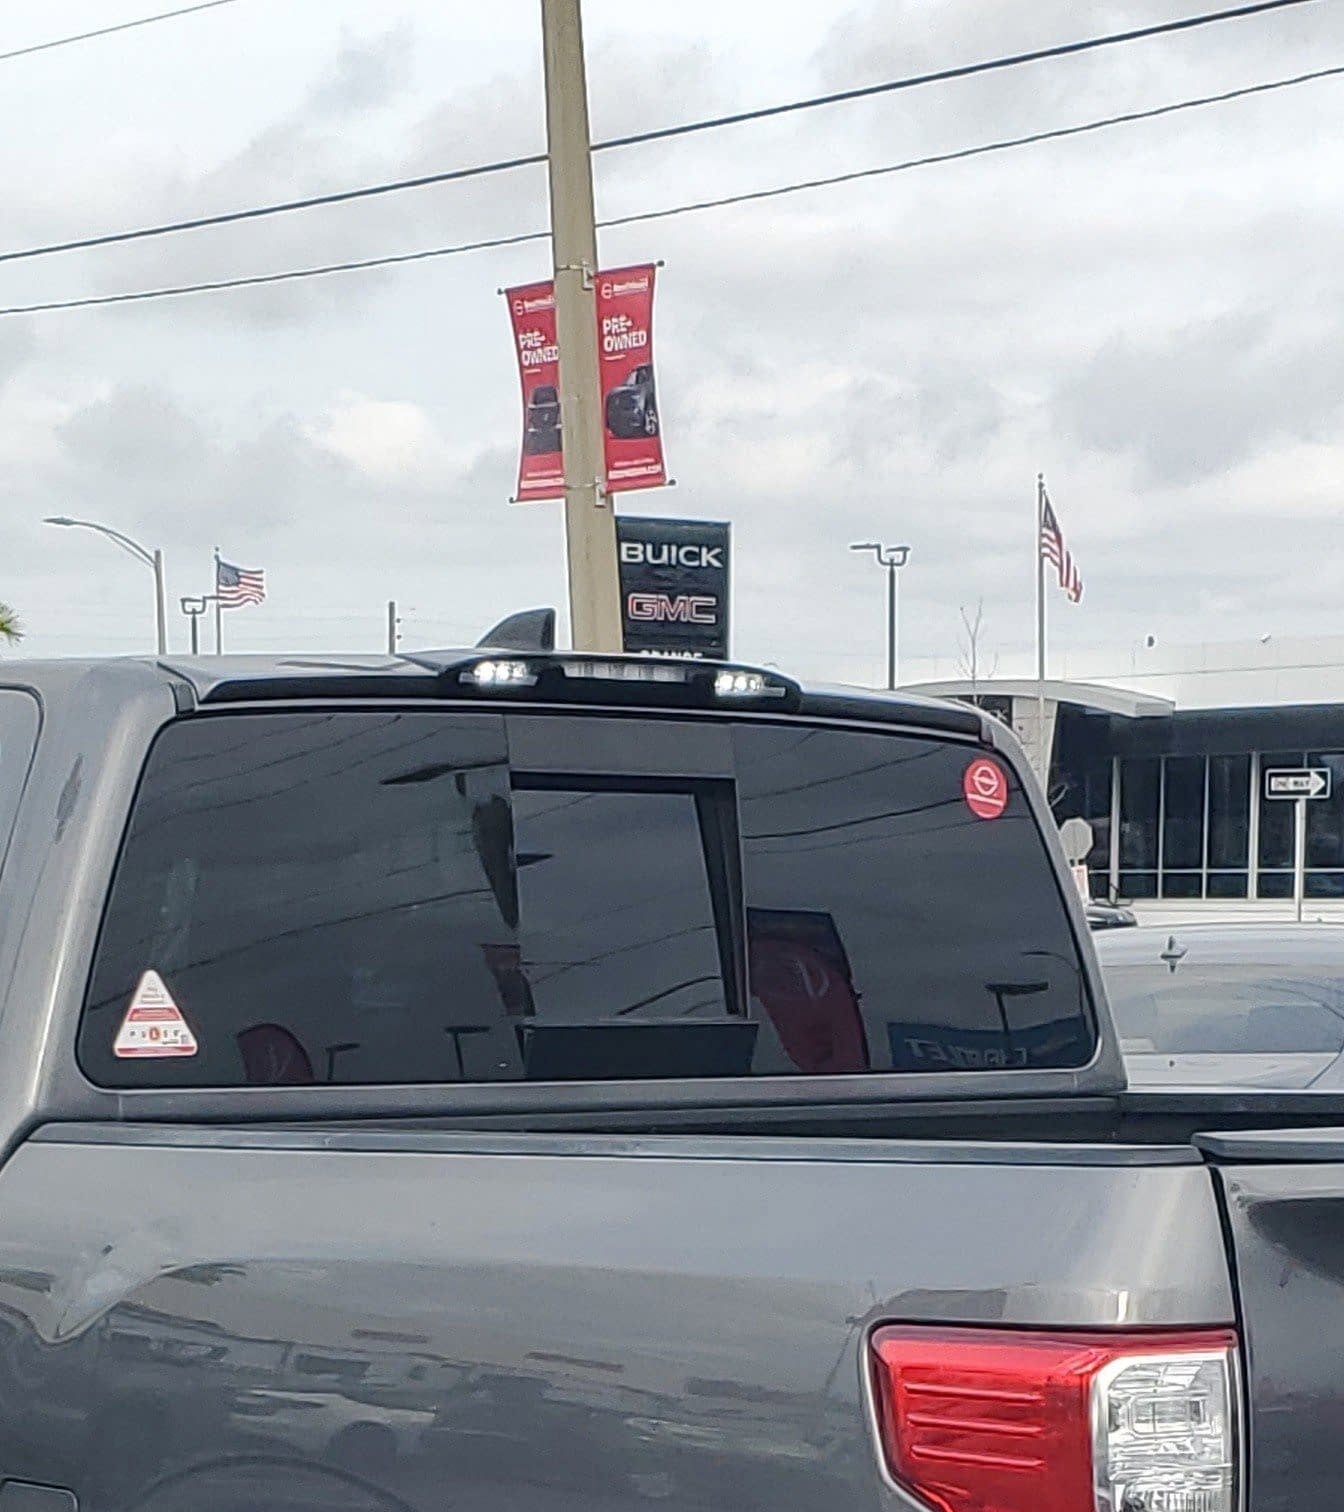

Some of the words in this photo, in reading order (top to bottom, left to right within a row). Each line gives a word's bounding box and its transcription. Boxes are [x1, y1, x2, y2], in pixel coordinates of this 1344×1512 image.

[603, 330, 647, 352] OWNED
[620, 541, 723, 568] BUICK
[627, 592, 716, 624] GMC
